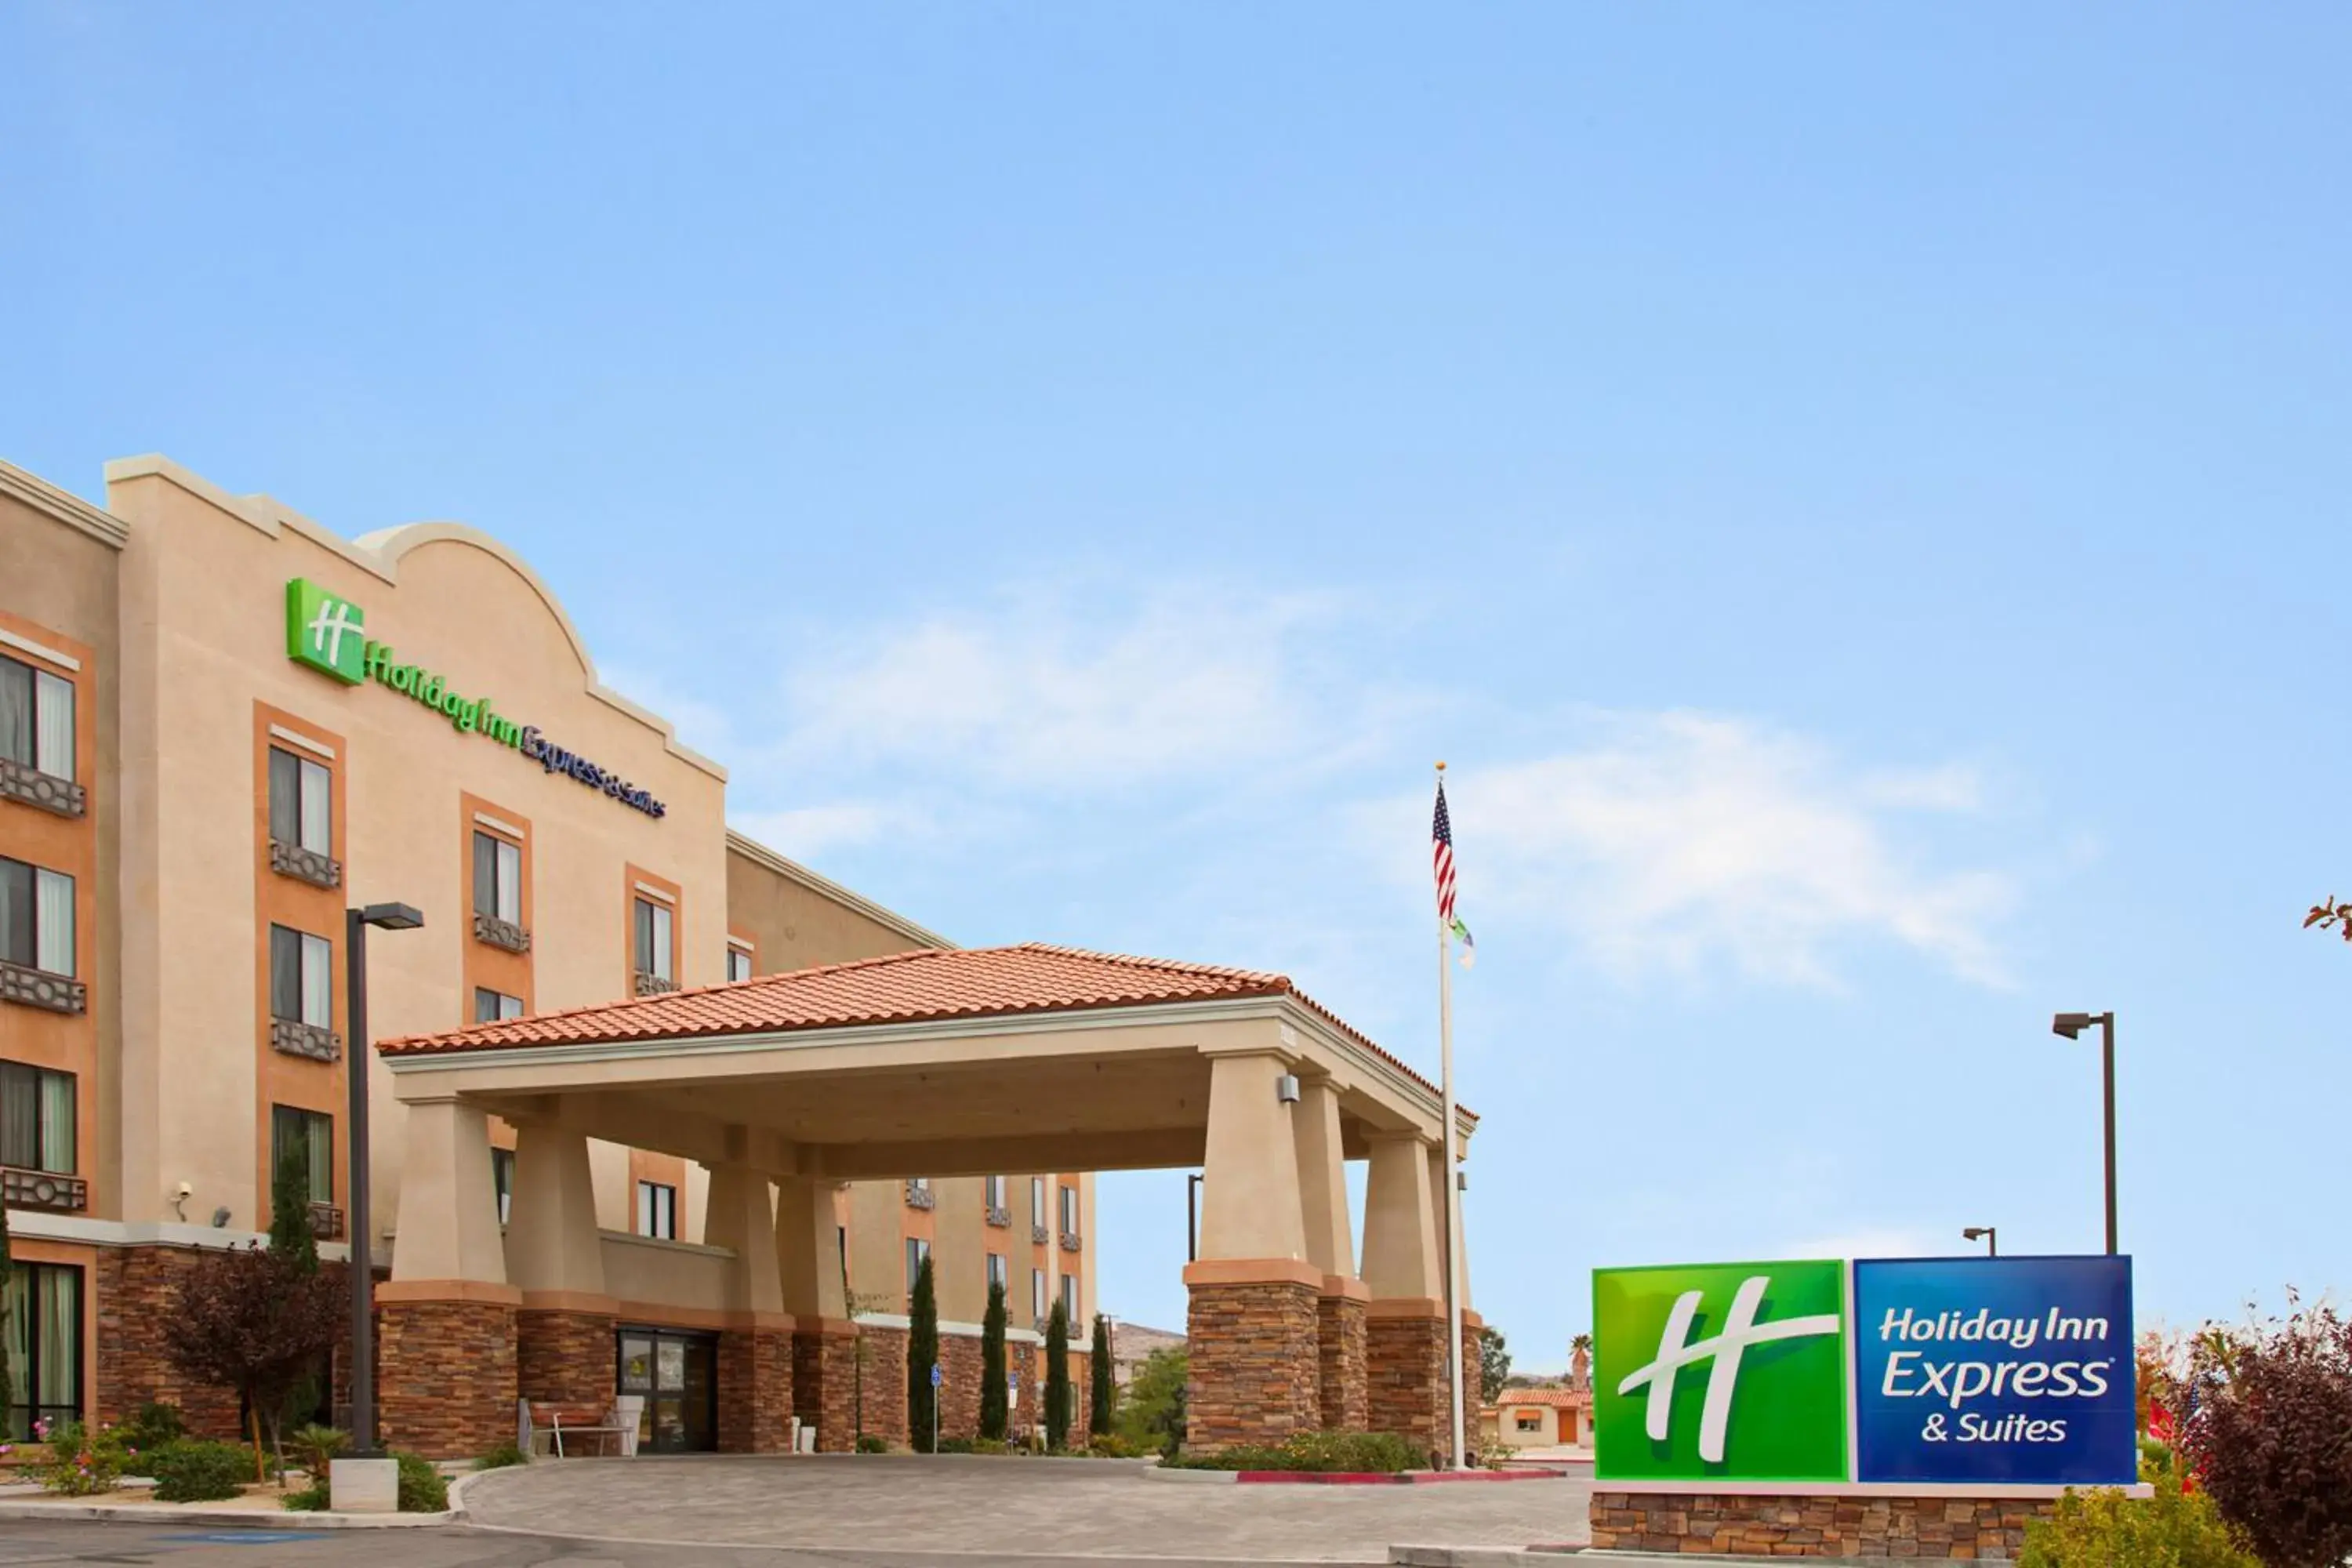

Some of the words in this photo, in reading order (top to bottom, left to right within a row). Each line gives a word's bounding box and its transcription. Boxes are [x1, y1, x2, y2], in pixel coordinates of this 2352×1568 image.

[308, 599, 364, 667] H
[364, 640, 480, 733] Holiday
[476, 698, 521, 748] Inn
[521, 725, 607, 789] Express
[1878, 1307, 2040, 1350] Holiday
[2044, 1306, 2110, 1341] Inn
[1617, 1276, 1840, 1463] H
[1881, 1350, 2111, 1410] Express
[1921, 1413, 1949, 1443] &
[1955, 1413, 2068, 1443] Suites
